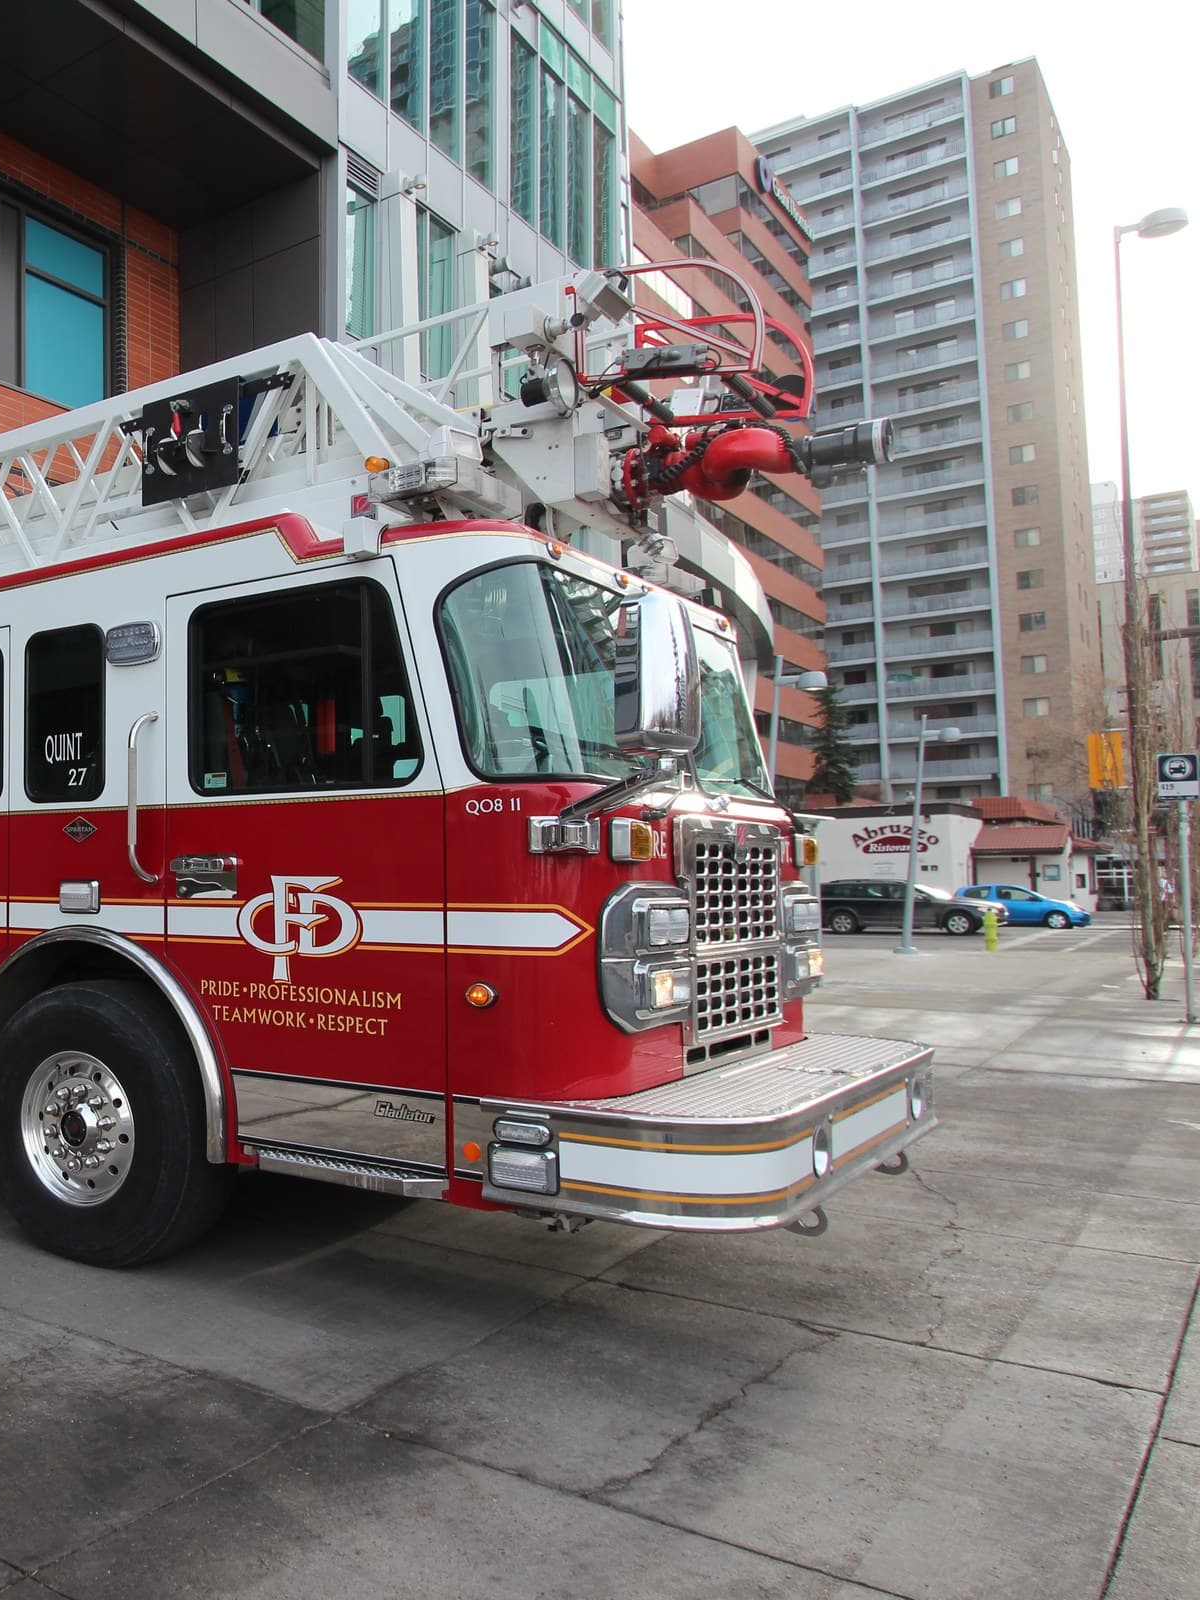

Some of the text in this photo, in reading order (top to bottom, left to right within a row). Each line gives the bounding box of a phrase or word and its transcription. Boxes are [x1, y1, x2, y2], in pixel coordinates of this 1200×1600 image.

[45, 732, 83, 764] QUINT
[68, 768, 87, 786] 27
[510, 797, 521, 812] 11
[652, 830, 668, 859] RE
[374, 1100, 435, 1124] Gladiator
